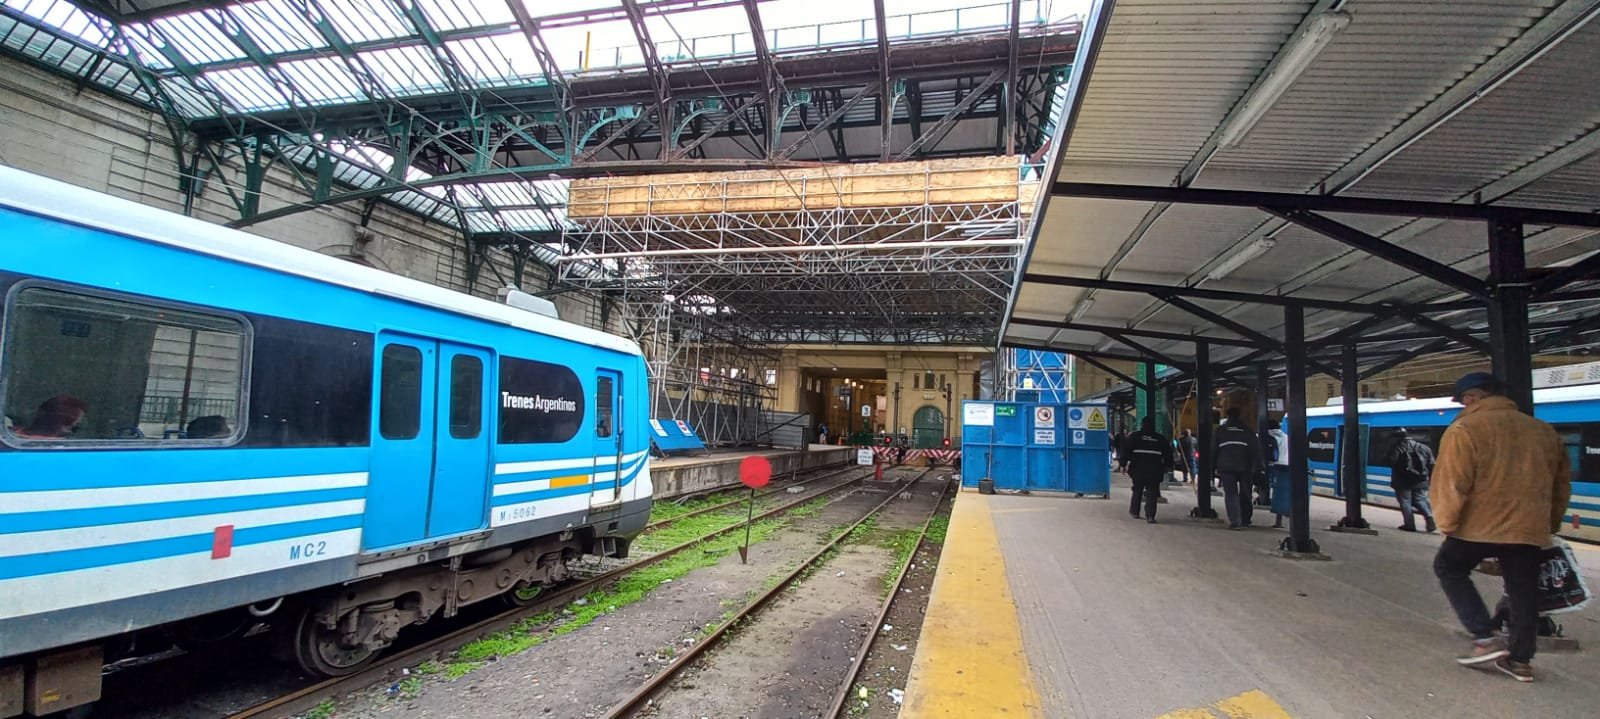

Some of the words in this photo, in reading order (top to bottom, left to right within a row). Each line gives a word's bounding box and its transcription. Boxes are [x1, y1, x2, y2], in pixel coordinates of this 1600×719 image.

[502, 391, 534, 409] Trenes
[535, 394, 576, 413] Argentinos
[290, 541, 326, 560] MC2
